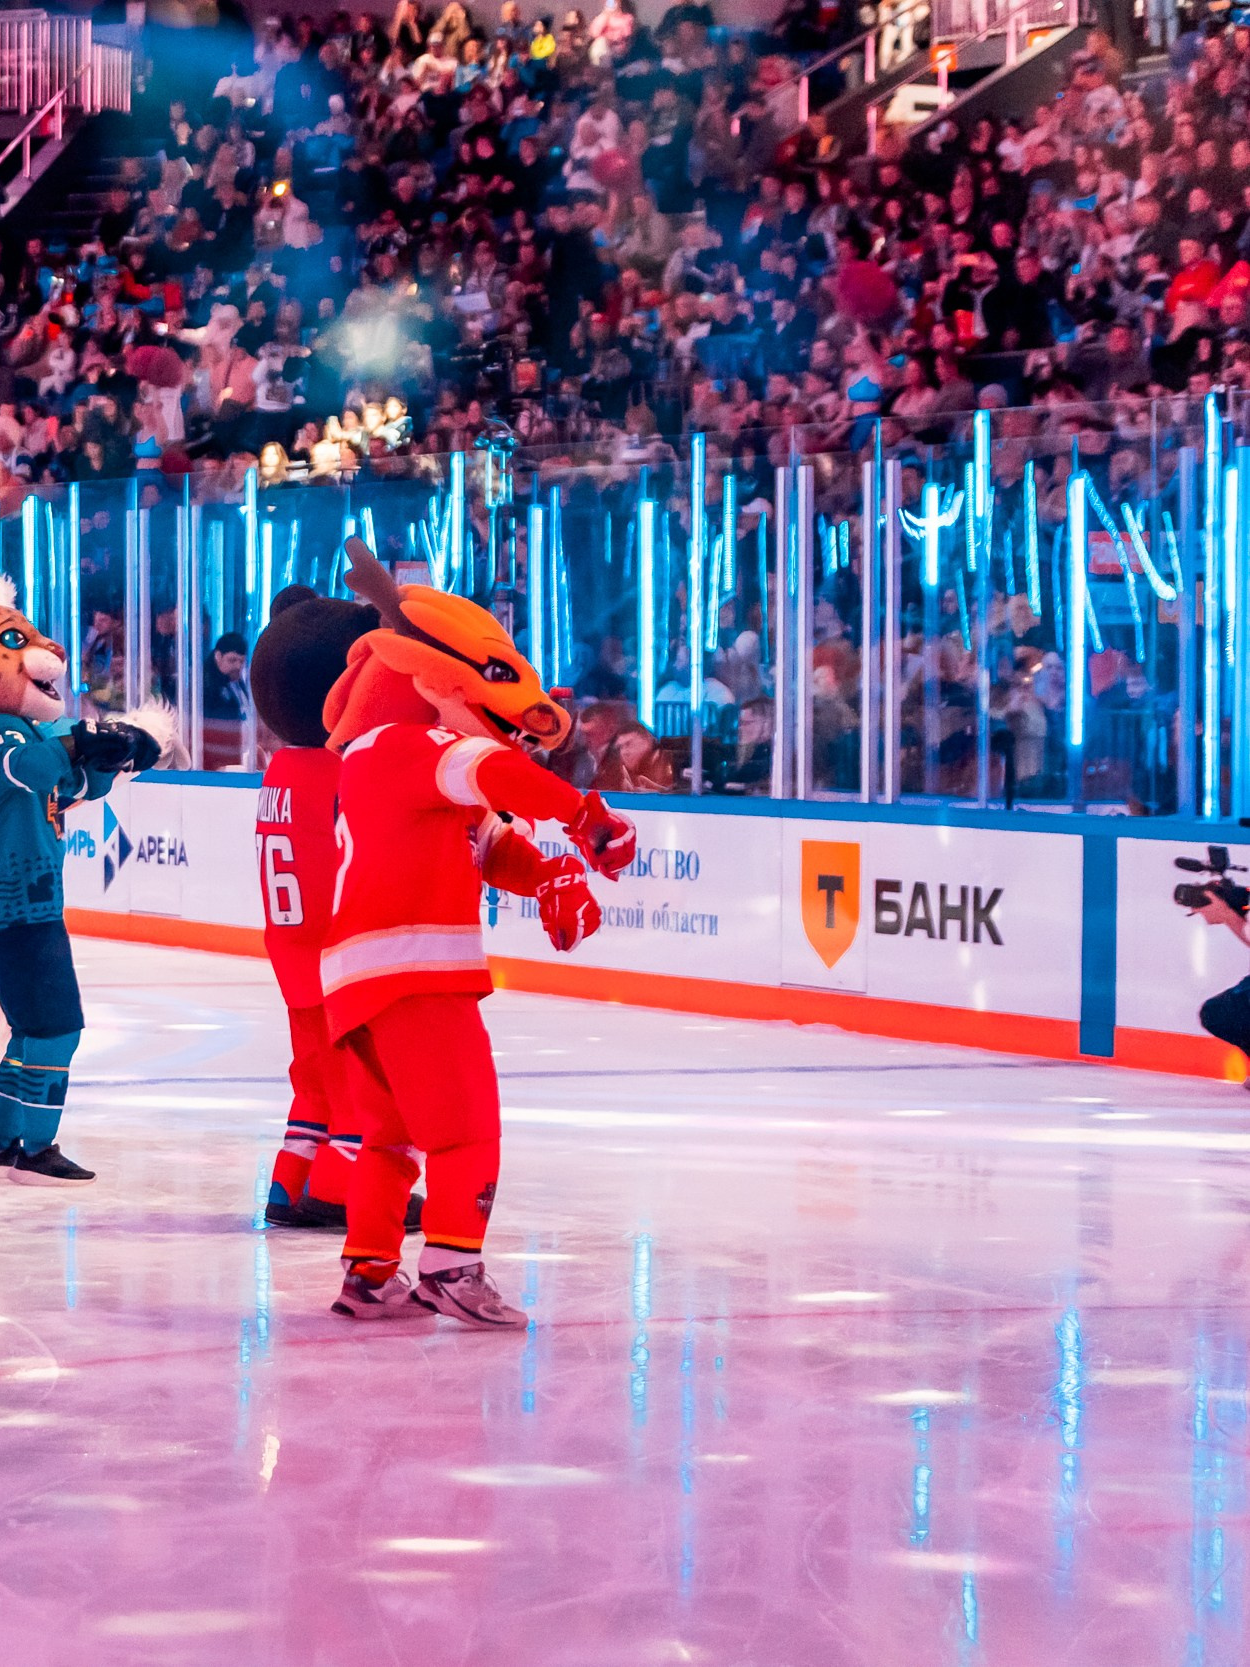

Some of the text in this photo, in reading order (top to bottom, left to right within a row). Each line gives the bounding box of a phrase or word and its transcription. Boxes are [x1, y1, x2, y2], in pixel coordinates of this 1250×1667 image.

[136, 835, 189, 867] АРЕНА
[536, 872, 587, 898] CCM
[652, 902, 719, 937] области
[874, 878, 1005, 946] БАНК
